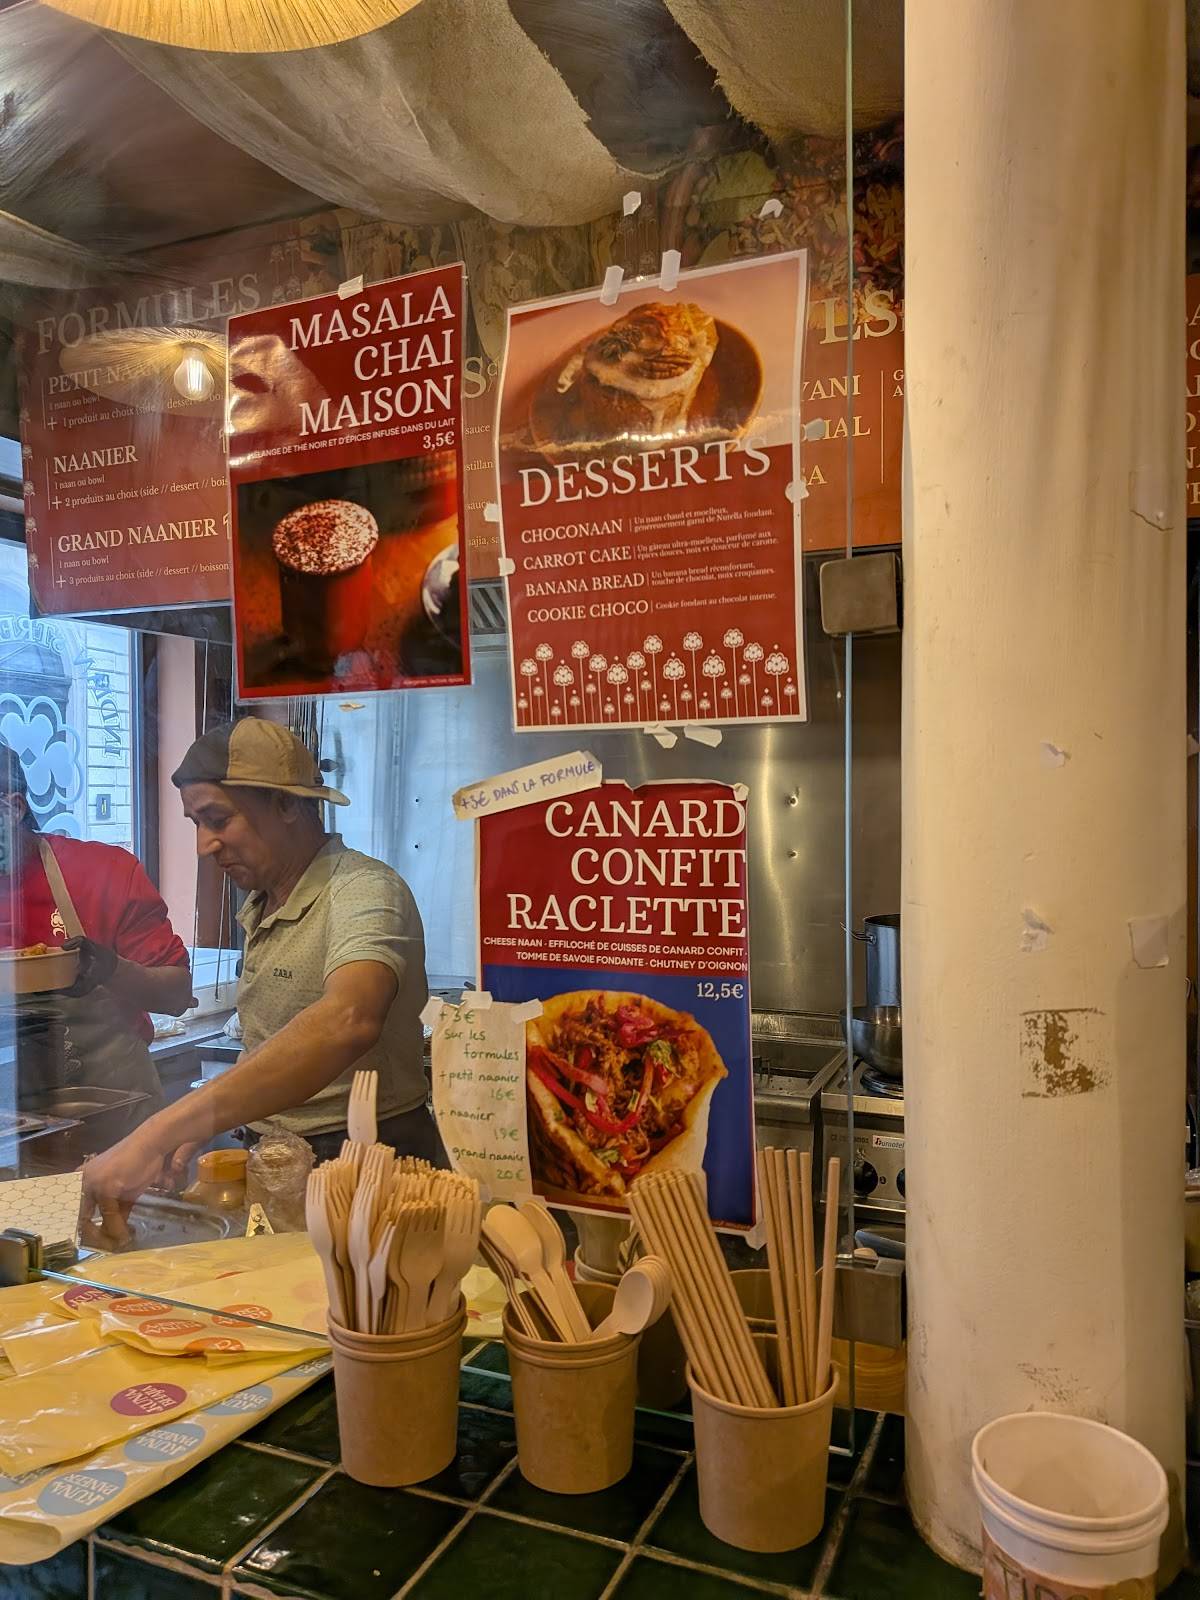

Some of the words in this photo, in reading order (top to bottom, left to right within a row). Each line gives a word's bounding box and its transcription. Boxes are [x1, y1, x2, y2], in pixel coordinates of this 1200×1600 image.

[35, 273, 261, 355] FORMULES
[289, 285, 455, 351] MASALA
[354, 329, 455, 381] CHAI
[49, 368, 101, 395] PETIT
[68, 412, 98, 428] produit
[100, 412, 110, 421] au
[111, 408, 135, 419] choix
[299, 374, 455, 437] MAISON
[282, 445, 293, 454] DE
[309, 440, 328, 450] NOIR
[328, 438, 337, 446] ET
[401, 423, 424, 434] DANS
[424, 420, 437, 429] DU
[438, 417, 455, 428] LAIT
[422, 431, 455, 450] 3,5€
[53, 445, 139, 474] NAANIER
[518, 436, 771, 508] DESSERTS
[59, 480, 77, 489] naan
[77, 479, 87, 487] ou
[87, 475, 105, 485] bowl
[65, 497, 70, 507] 2
[71, 493, 104, 509] produits
[105, 492, 116, 501] au
[117, 488, 139, 500] choix
[140, 486, 159, 498] (side
[170, 481, 200, 493] dessert
[521, 518, 623, 544] CHOCONAAN
[634, 516, 645, 525] Un
[58, 529, 123, 552] GRAND
[127, 518, 219, 545] NAANIER
[63, 558, 81, 568] naan
[81, 557, 91, 566] ou
[91, 555, 109, 566] bowl
[523, 550, 587, 571] CARROT
[590, 545, 632, 564] CAKE
[69, 576, 74, 585] 3
[75, 572, 105, 587] produits
[105, 571, 115, 580] au
[115, 568, 136, 580] choix
[136, 566, 154, 579] (side
[163, 565, 190, 576] dessert
[525, 578, 588, 597] BANANA
[592, 572, 645, 591] BREAD
[527, 605, 586, 623] COOKIE
[589, 599, 649, 618] CHOCO
[493, 780, 520, 801] DANS
[523, 778, 537, 793] LA
[541, 761, 595, 787] FORMULE
[545, 799, 747, 838] CANARD
[571, 847, 747, 888] CONFIT
[506, 892, 747, 938] RACLETTE
[483, 936, 517, 947] CHEESE
[517, 938, 543, 947] NAAN
[548, 939, 596, 950] EFFILOCHÉ
[597, 942, 609, 951] DE
[610, 942, 648, 954] CUISSES
[648, 945, 661, 954] DE
[662, 945, 705, 956] CANARD
[706, 946, 744, 957] CONFIT
[516, 951, 548, 961] TOMME
[549, 953, 561, 962] DE
[562, 953, 595, 964] SAVOIE
[596, 956, 644, 967] FONDANTE
[649, 959, 696, 970] CHUTNEY
[698, 960, 748, 972] D'OIGNON
[696, 982, 744, 1001] 12,5€
[469, 1028, 486, 1041] les
[463, 1045, 520, 1062] formules
[448, 1068, 473, 1089] petit
[478, 1069, 520, 1083] naanier
[449, 1106, 495, 1122] naanier
[451, 1146, 487, 1161] grand
[496, 1168, 525, 1182] 20€
